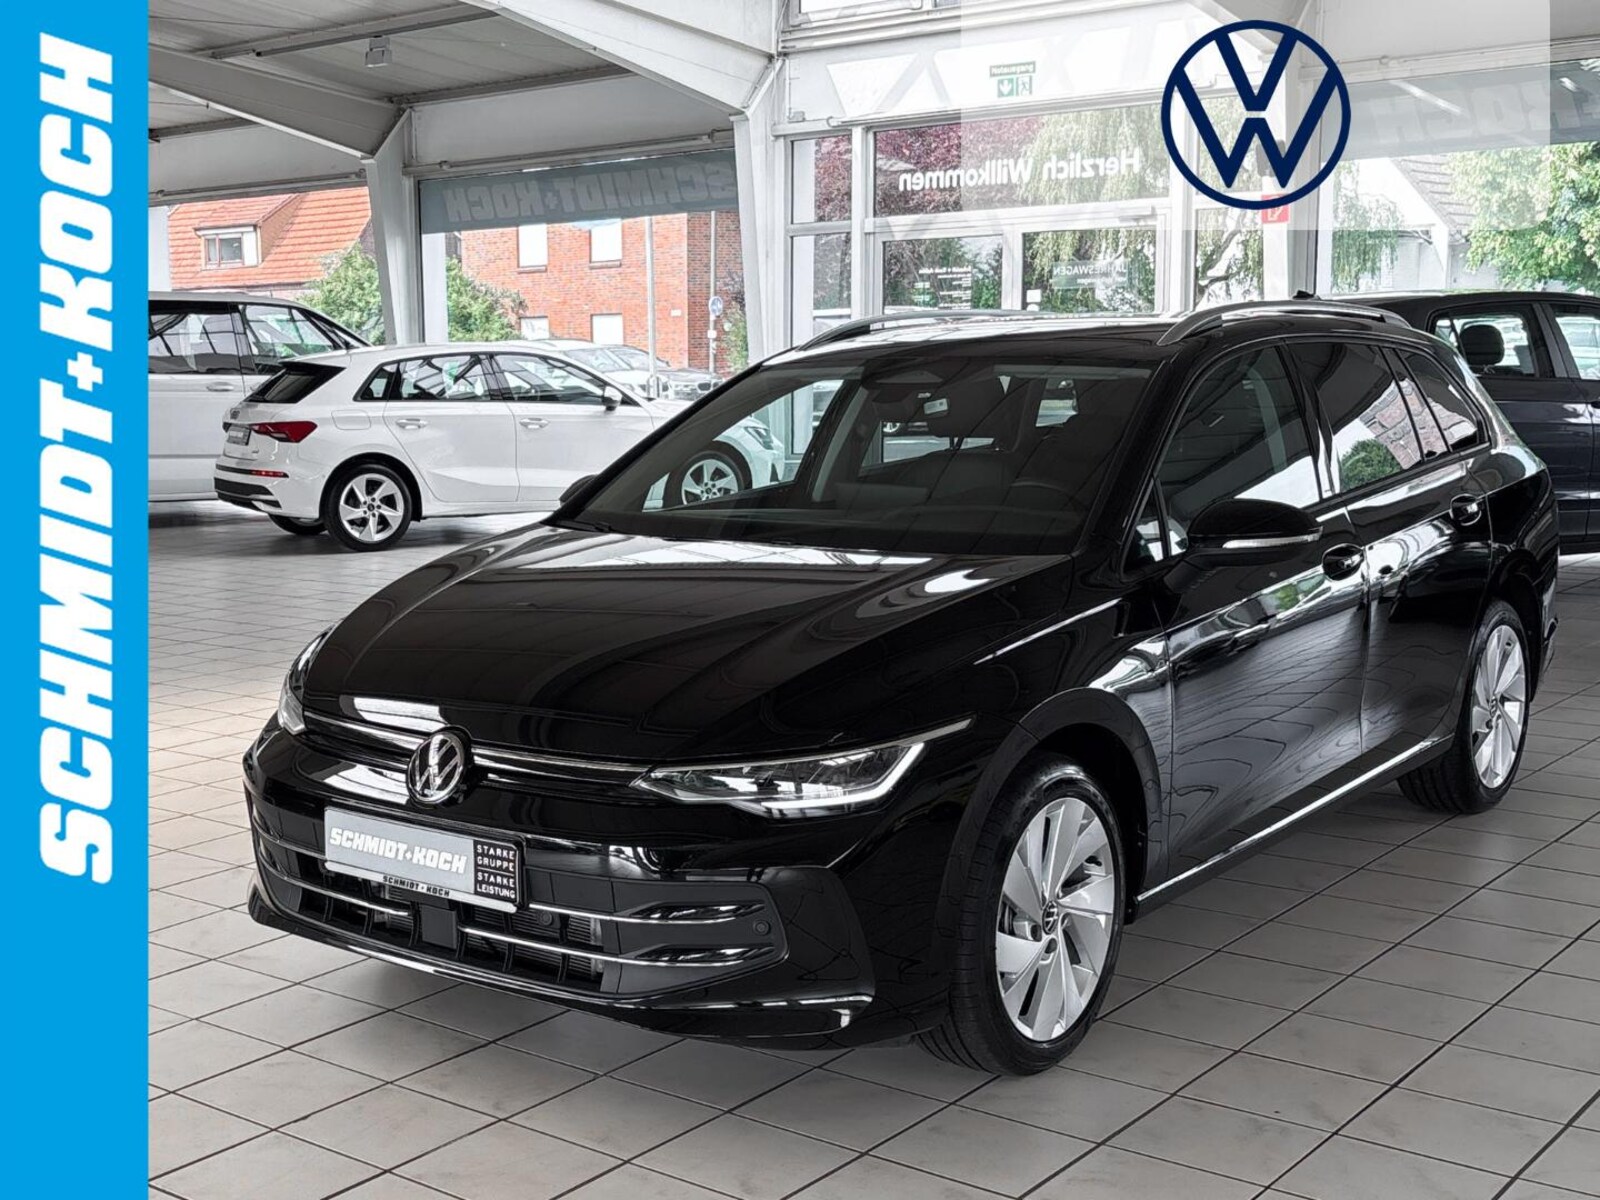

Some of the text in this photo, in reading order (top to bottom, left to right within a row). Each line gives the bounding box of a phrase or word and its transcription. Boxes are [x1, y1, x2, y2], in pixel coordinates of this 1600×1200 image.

[329, 828, 468, 874] SCHMIDT+KOCH
[476, 844, 515, 860] STARKE
[476, 857, 515, 871] GRUPPE
[382, 875, 420, 890] SCHMIDT
[426, 885, 450, 897] KOCH
[476, 872, 515, 888] STARKE
[476, 883, 516, 899] LEISTUNG
